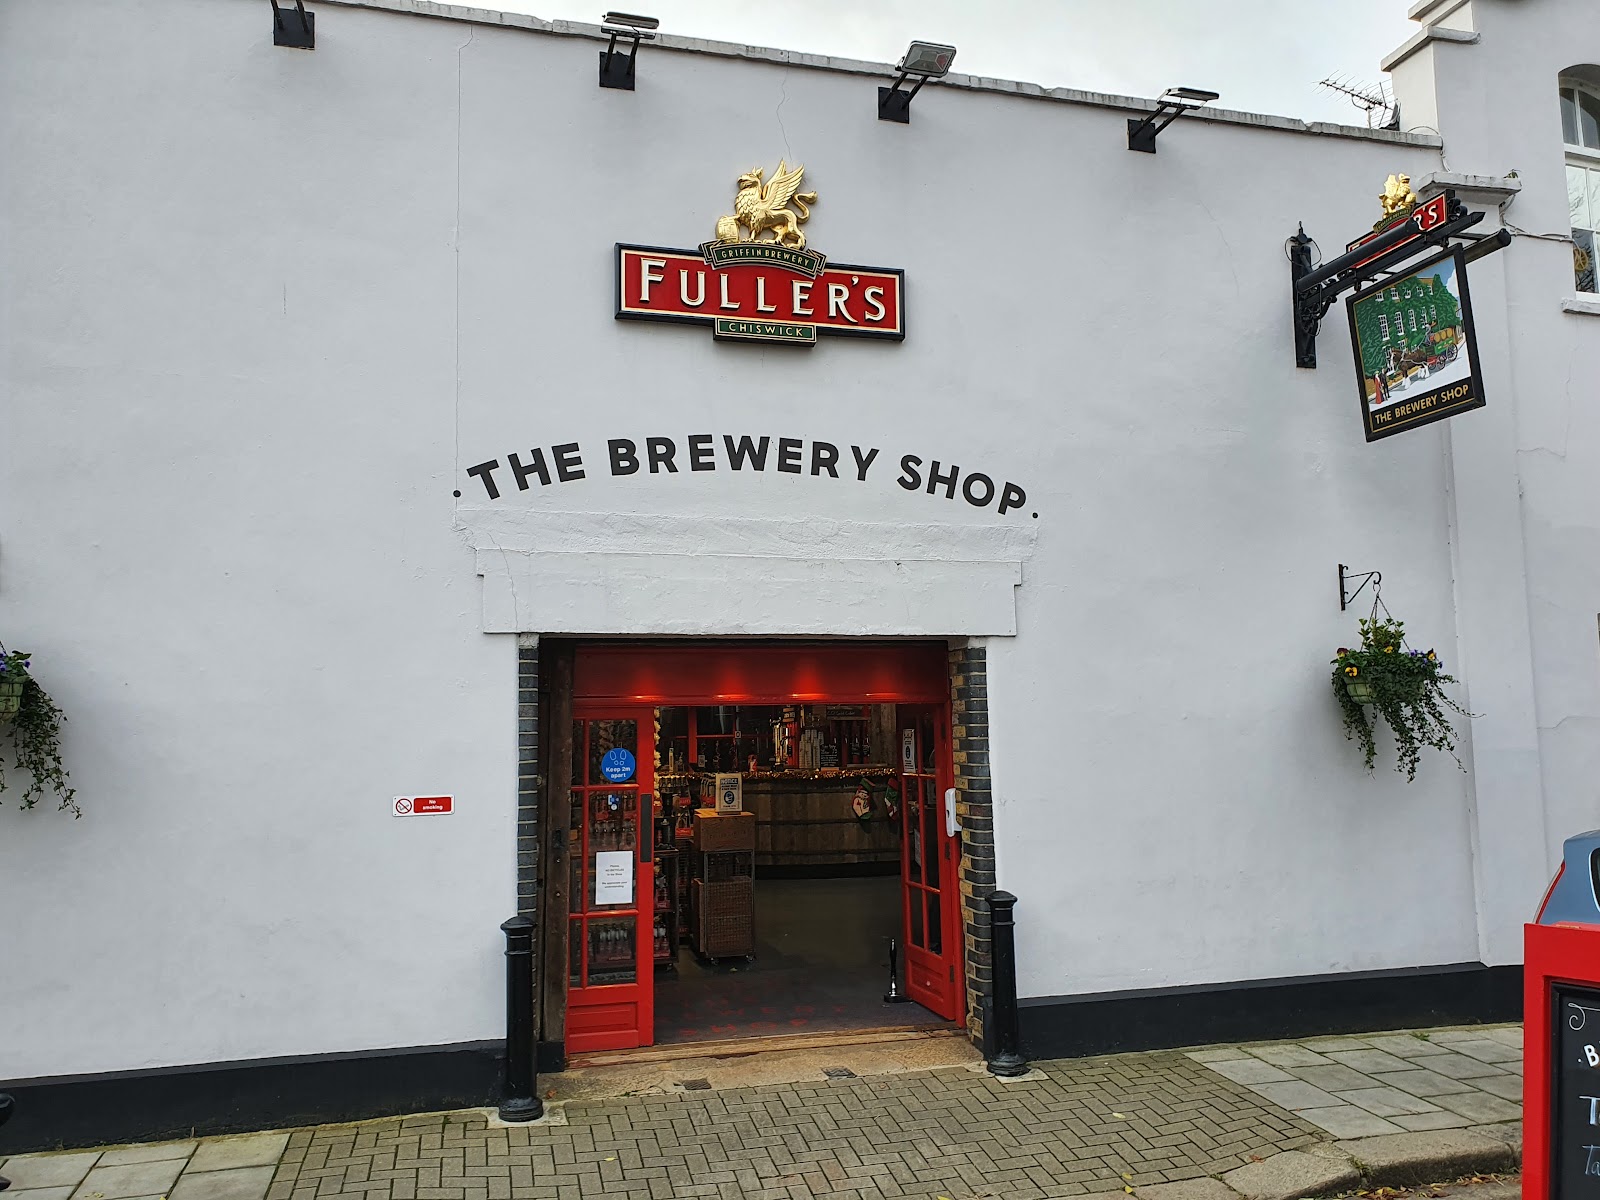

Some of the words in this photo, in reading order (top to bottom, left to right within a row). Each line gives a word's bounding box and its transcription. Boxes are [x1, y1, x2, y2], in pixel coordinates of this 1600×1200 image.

[721, 248, 762, 259] GRIFFIN
[765, 249, 809, 266] BREWERY
[639, 257, 886, 323] FULLER'S
[728, 322, 803, 337] CHISWICK
[1374, 411, 1393, 425] THE
[1394, 394, 1438, 418] BREWERY
[1440, 384, 1469, 403] SHOP
[466, 442, 586, 501] THE
[607, 434, 880, 481] BREWERY
